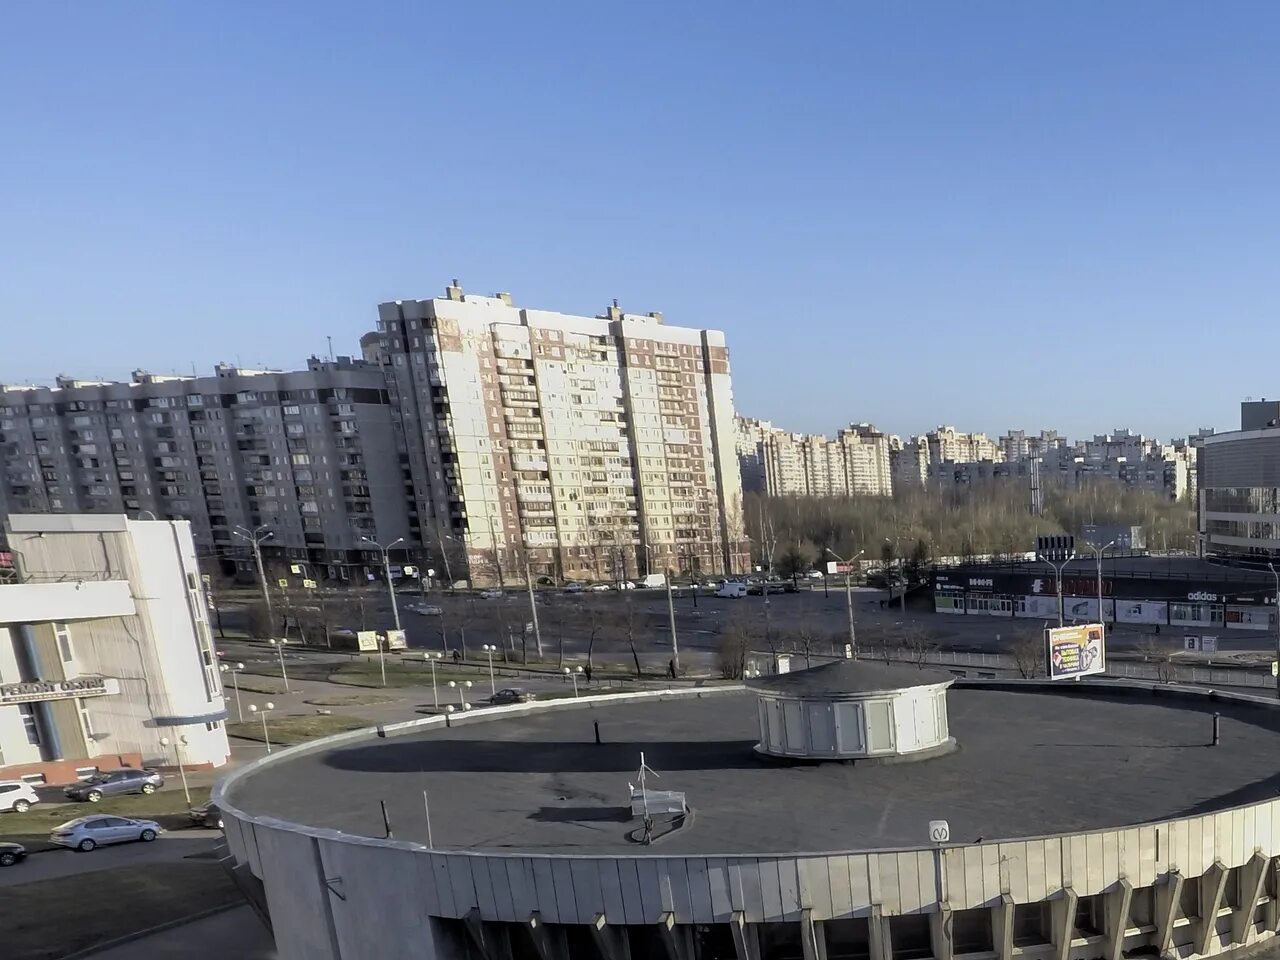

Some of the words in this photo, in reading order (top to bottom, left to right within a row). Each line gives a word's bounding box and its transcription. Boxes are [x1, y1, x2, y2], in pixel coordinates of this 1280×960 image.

[1187, 591, 1218, 602] adidas
[0, 682, 56, 697] РЕМОНТ
[60, 679, 105, 691] ОБУВИ
